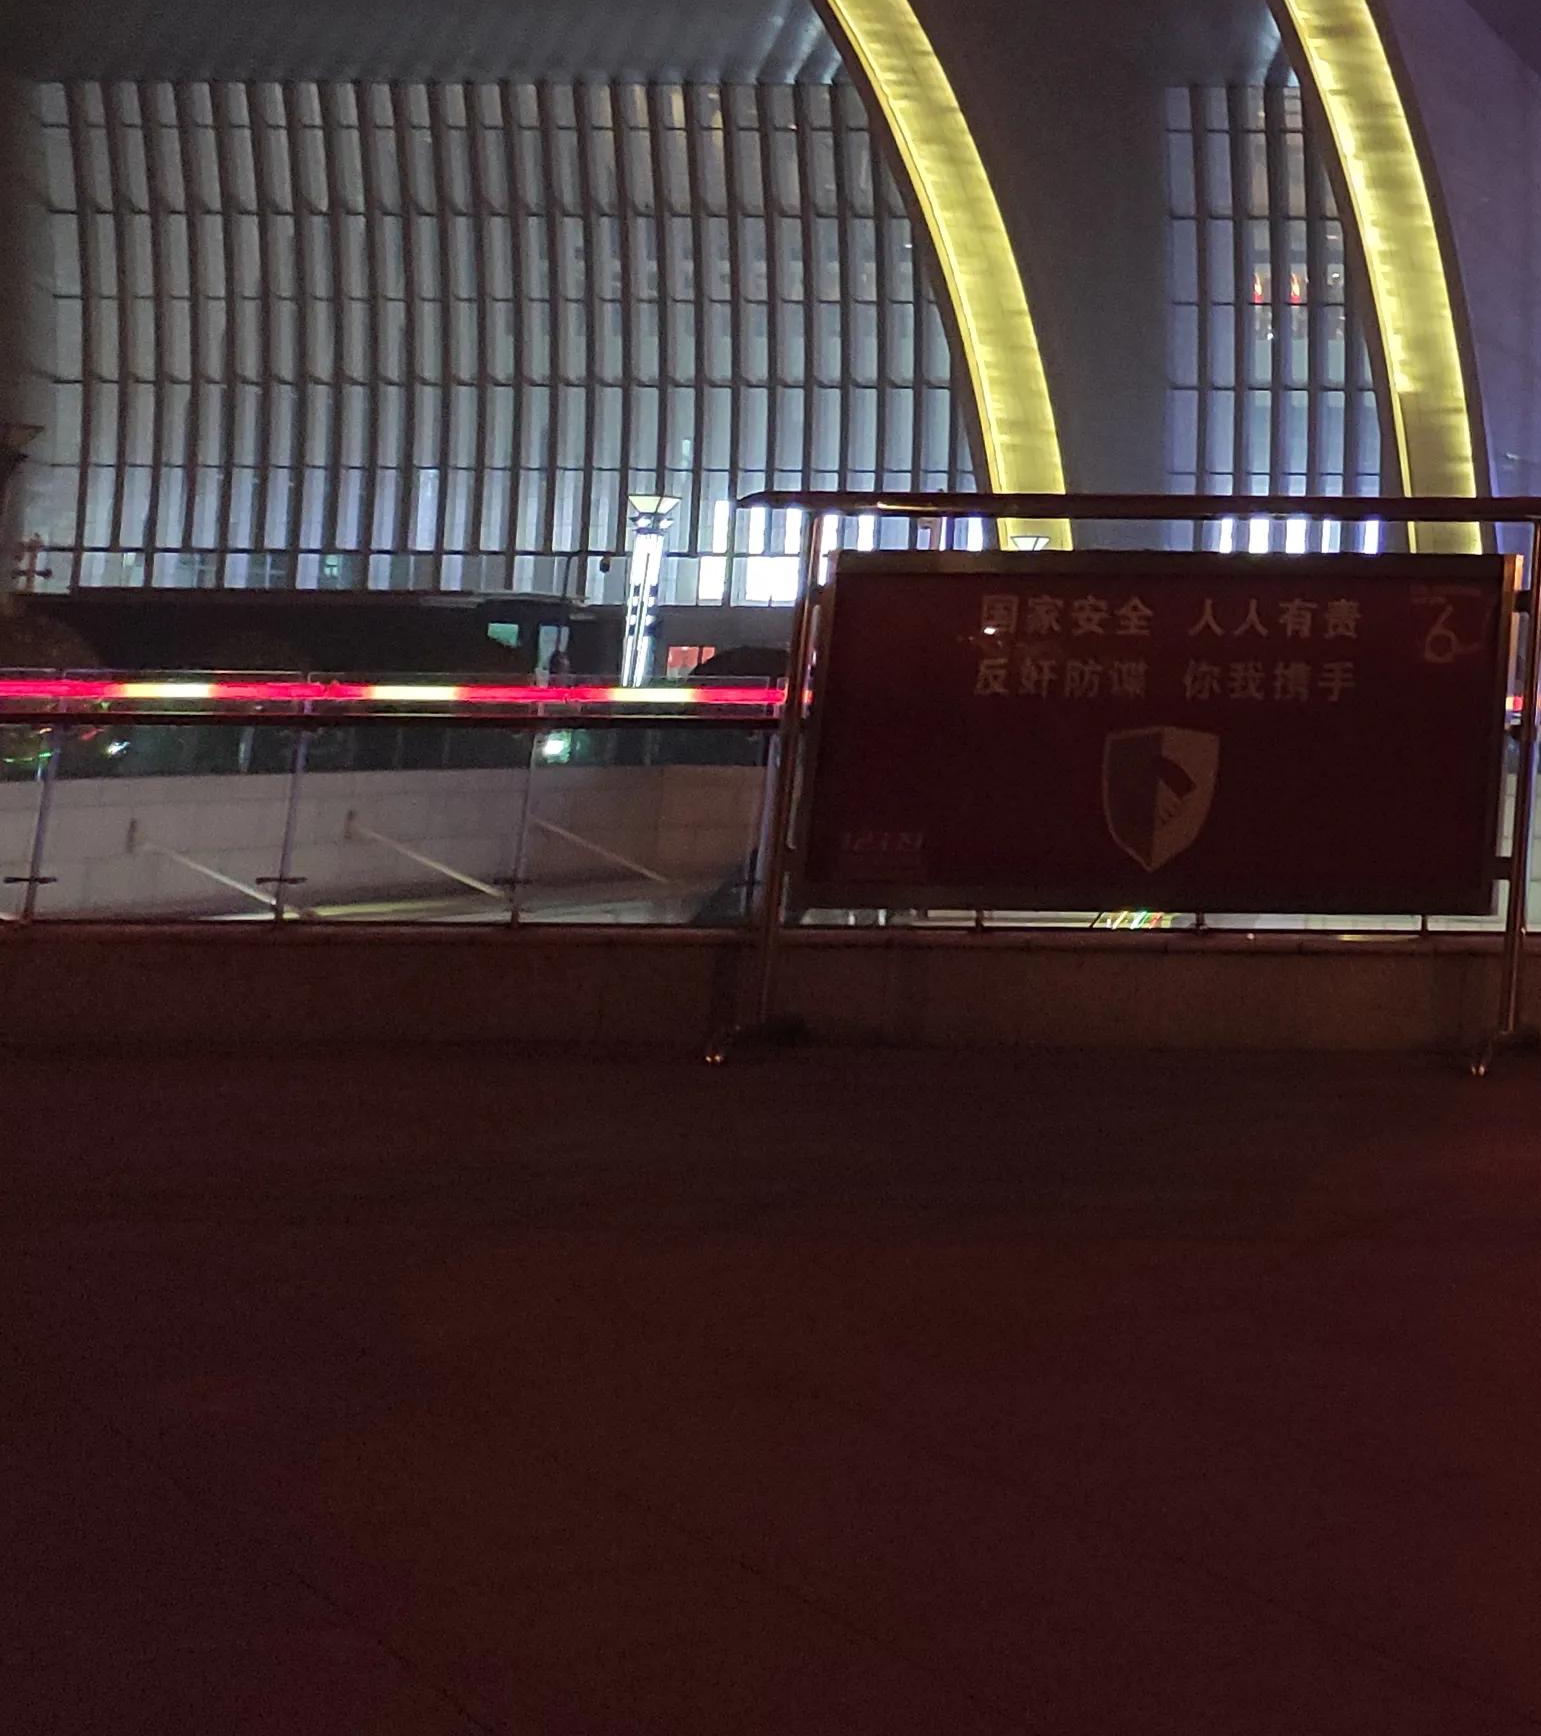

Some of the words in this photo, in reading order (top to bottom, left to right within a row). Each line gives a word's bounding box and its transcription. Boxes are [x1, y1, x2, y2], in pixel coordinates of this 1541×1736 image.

[982, 594, 1154, 636] 国家安全
[1188, 597, 1362, 639] 人人有责
[1183, 658, 1357, 702] 你我携手
